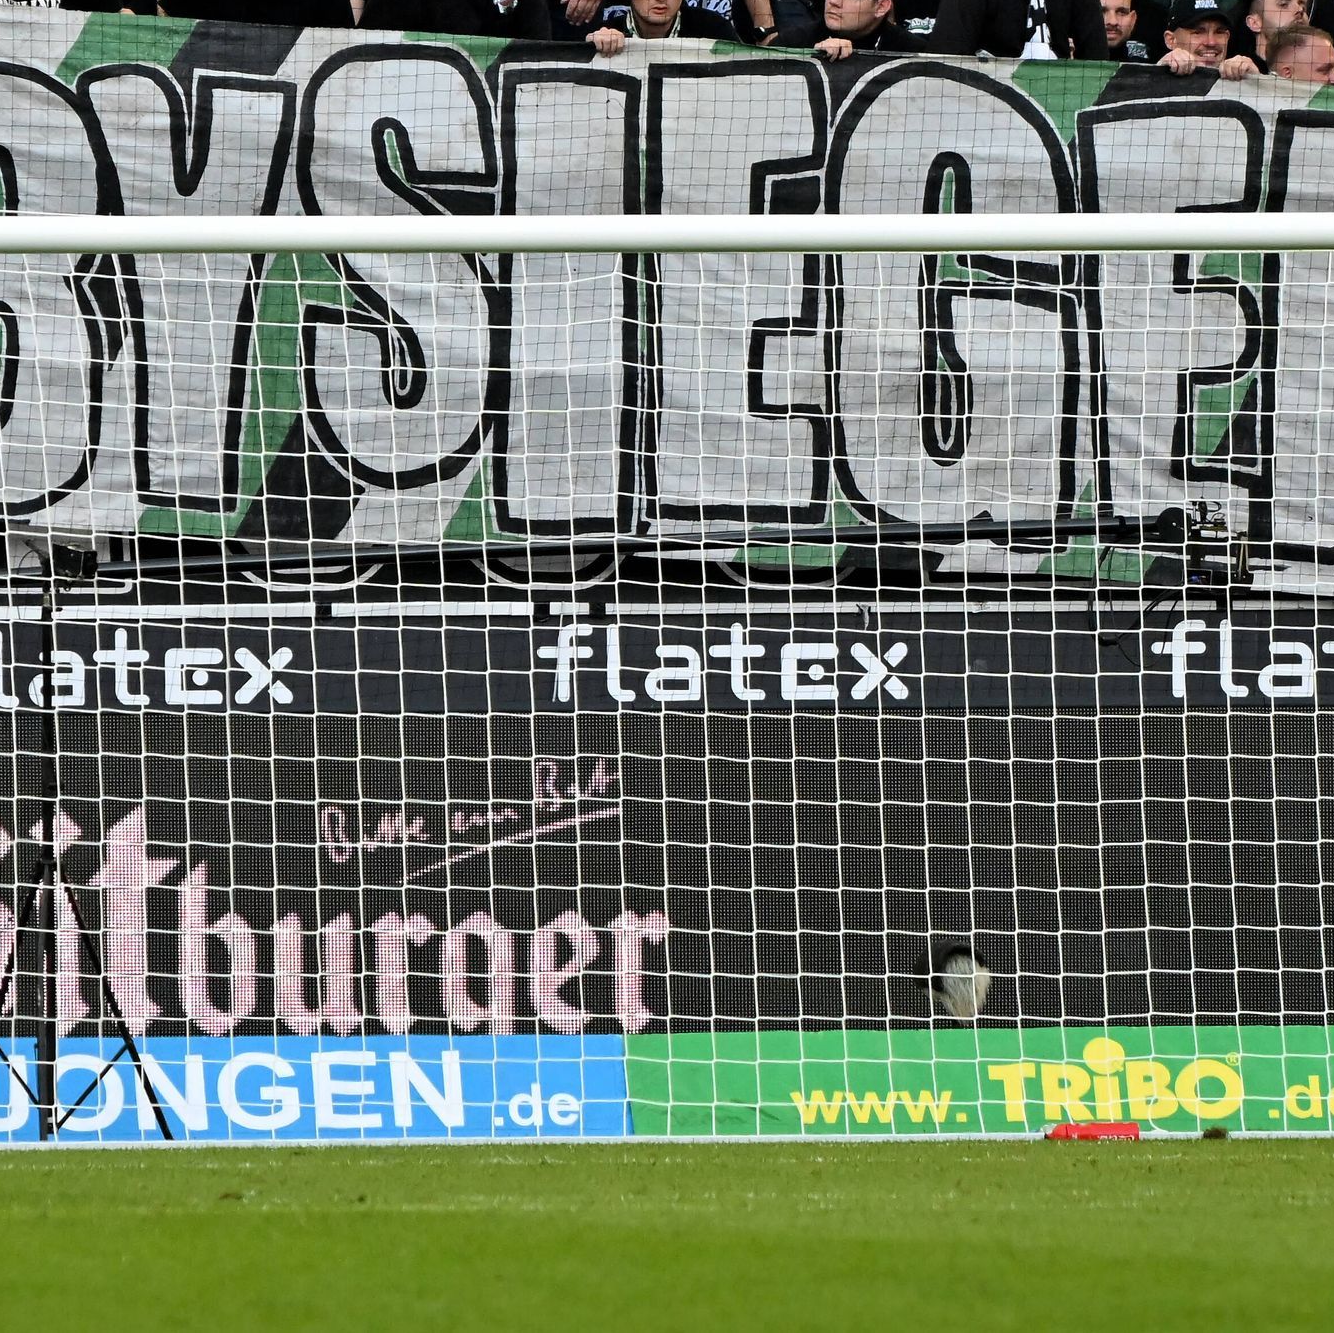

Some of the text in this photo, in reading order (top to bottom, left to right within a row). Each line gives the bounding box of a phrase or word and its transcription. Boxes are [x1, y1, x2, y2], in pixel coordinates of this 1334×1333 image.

[536, 622, 910, 702] flatex
[493, 1083, 581, 1127] .de
[791, 1089, 967, 1125] www.
